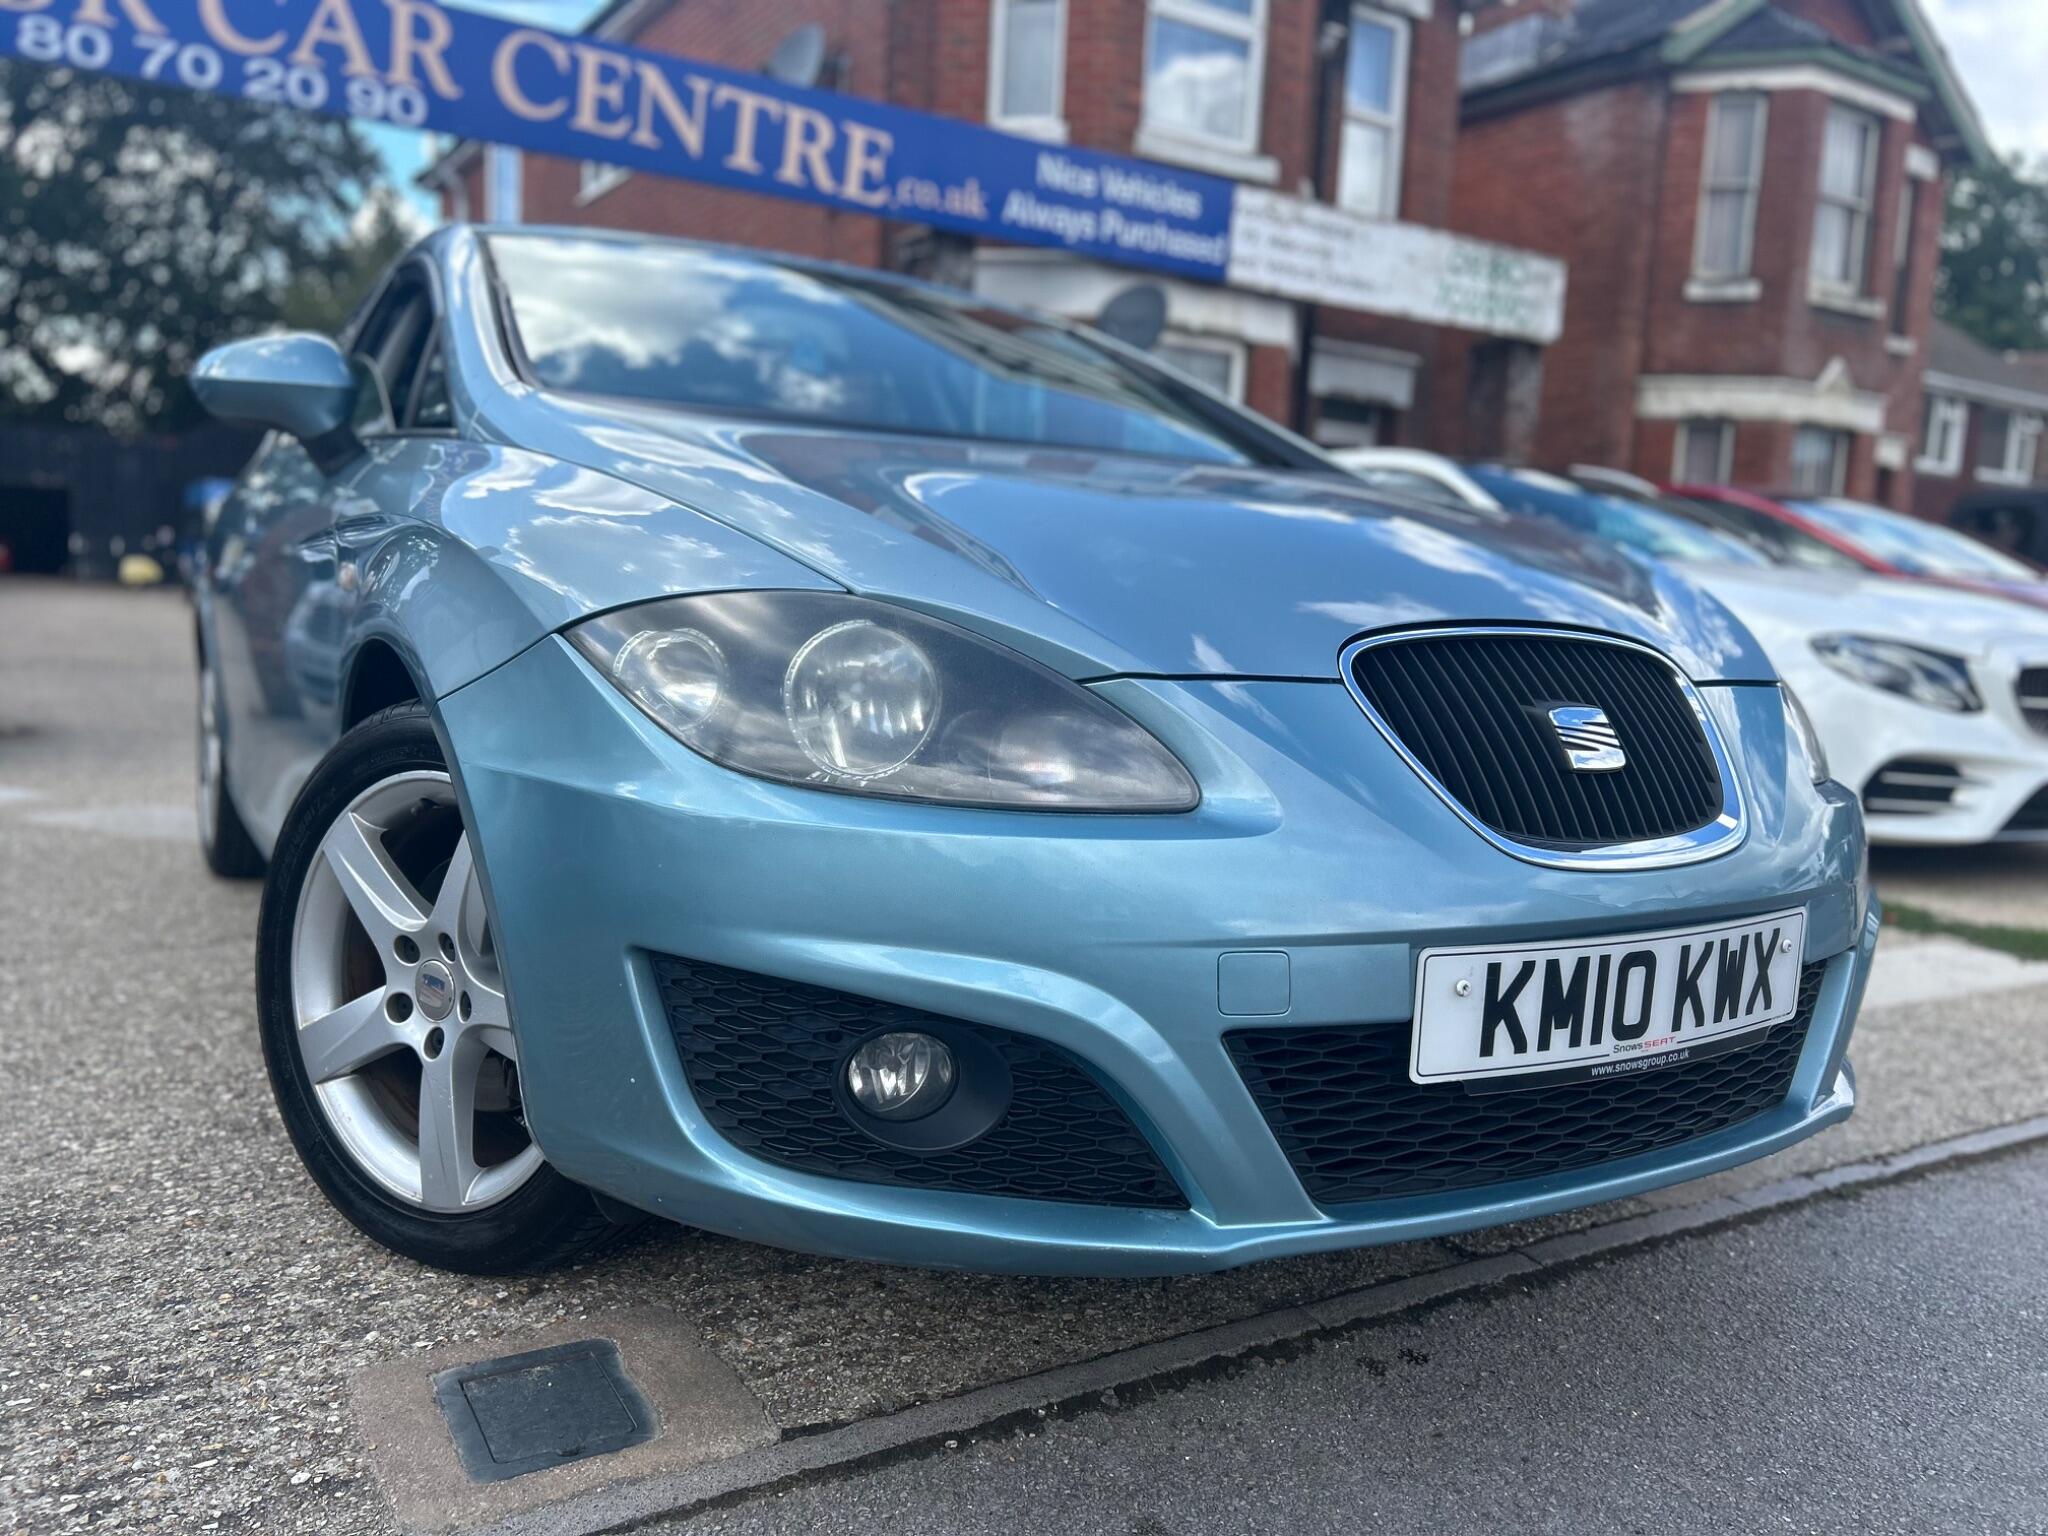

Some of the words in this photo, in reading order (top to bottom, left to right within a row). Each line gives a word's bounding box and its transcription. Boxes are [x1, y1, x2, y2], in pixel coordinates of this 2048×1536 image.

[16, 14, 113, 70] 80
[131, 32, 224, 89] 70
[241, 57, 328, 110] 20
[345, 75, 429, 127] 90
[196, 0, 463, 100] CAR
[1002, 189, 1097, 245] Always
[1036, 152, 1097, 198] Nice
[1101, 165, 1203, 220] Vehicles
[1479, 949, 1657, 1058] KM10
[1671, 928, 1781, 1032] KWX
[1591, 1047, 1690, 1077] www.snowsgroup.co.uk
